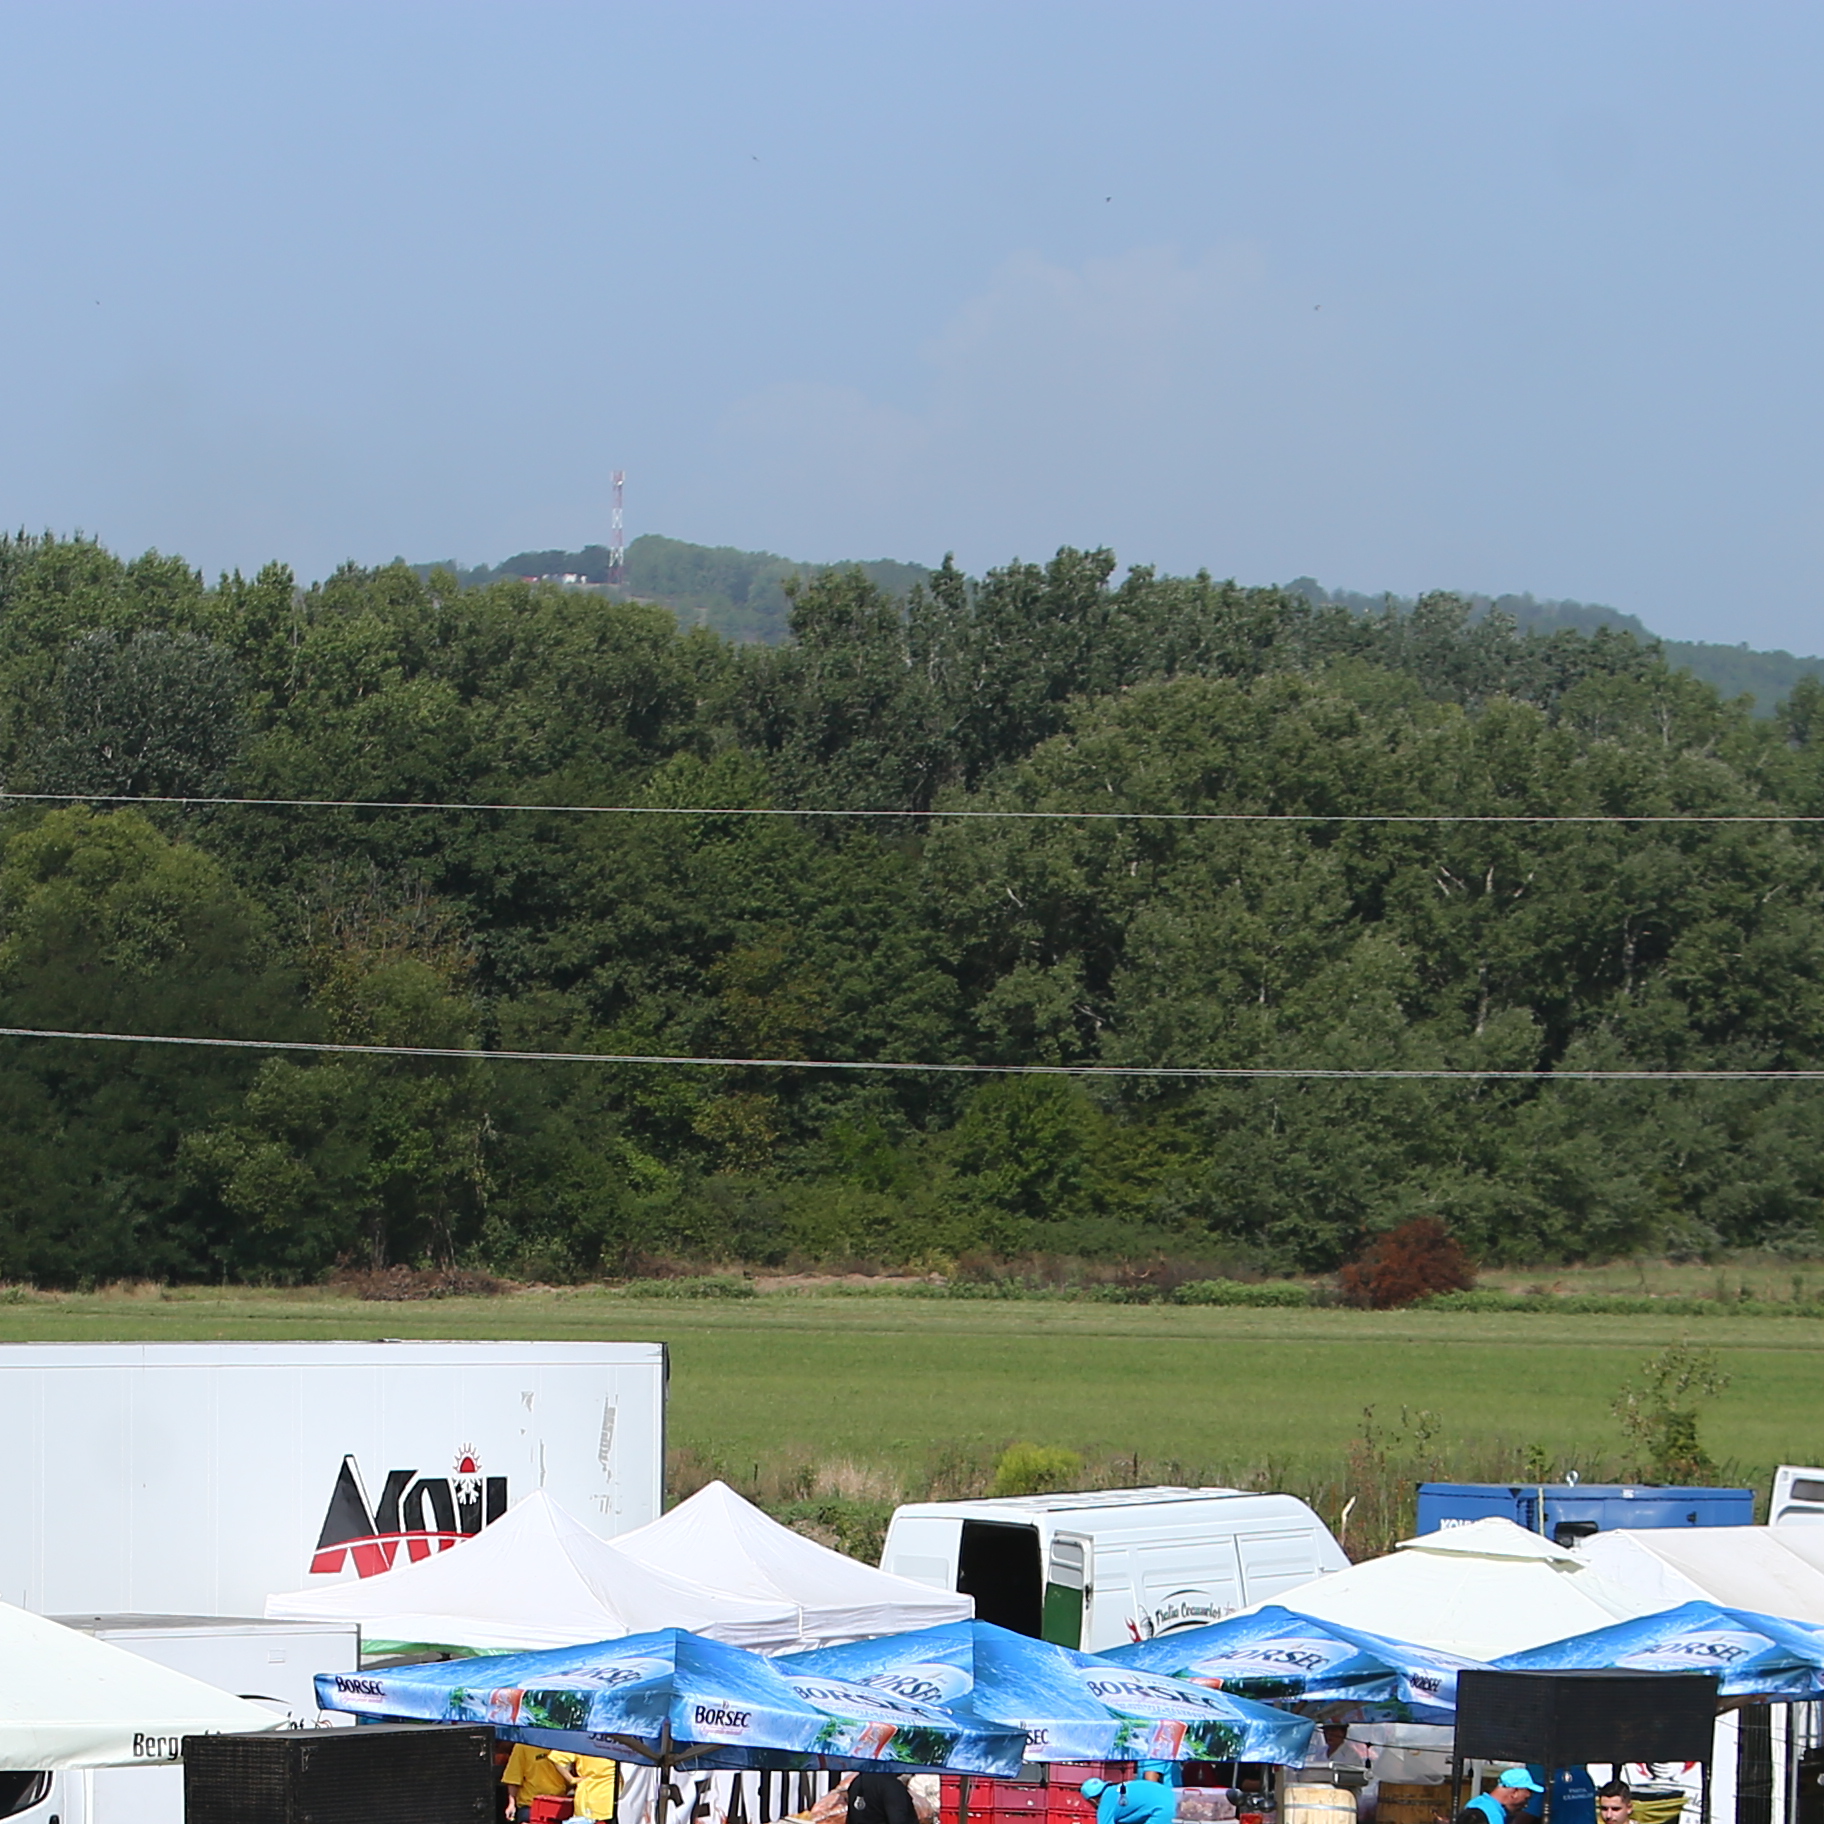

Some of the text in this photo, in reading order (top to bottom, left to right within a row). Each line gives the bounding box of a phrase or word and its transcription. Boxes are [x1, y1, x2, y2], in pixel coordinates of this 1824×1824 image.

[335, 1676, 386, 1698] BORSEC
[1087, 1680, 1231, 1714] BORSEC
[793, 1685, 934, 1720] BORSEC
[695, 1705, 752, 1727] BORSEC
[1026, 1729, 1049, 1746] SEC
